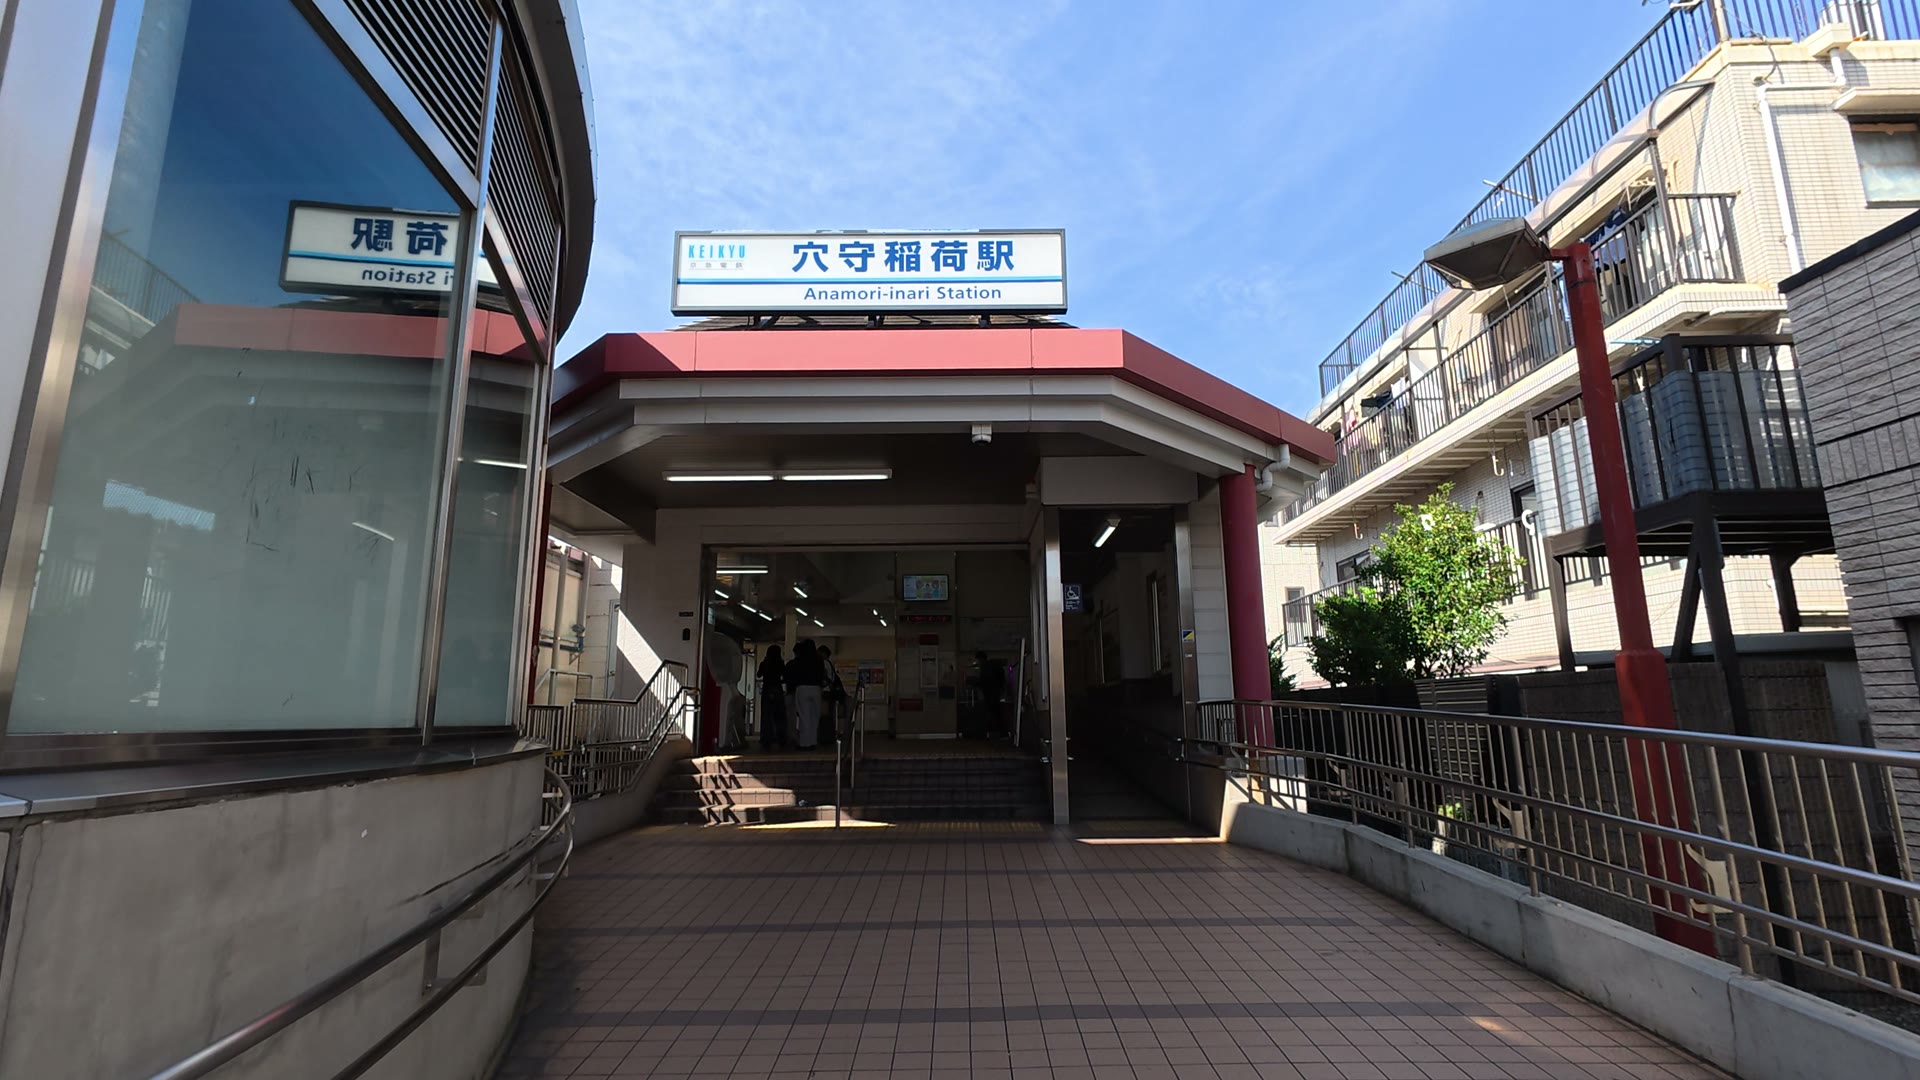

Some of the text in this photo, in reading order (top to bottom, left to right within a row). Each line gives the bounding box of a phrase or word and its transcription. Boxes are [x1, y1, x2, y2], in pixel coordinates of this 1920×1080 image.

[688, 244, 745, 258] KEIKYU
[791, 240, 1015, 273] 穴守稲荷駅
[804, 286, 1002, 300] Anamori-inari Station
